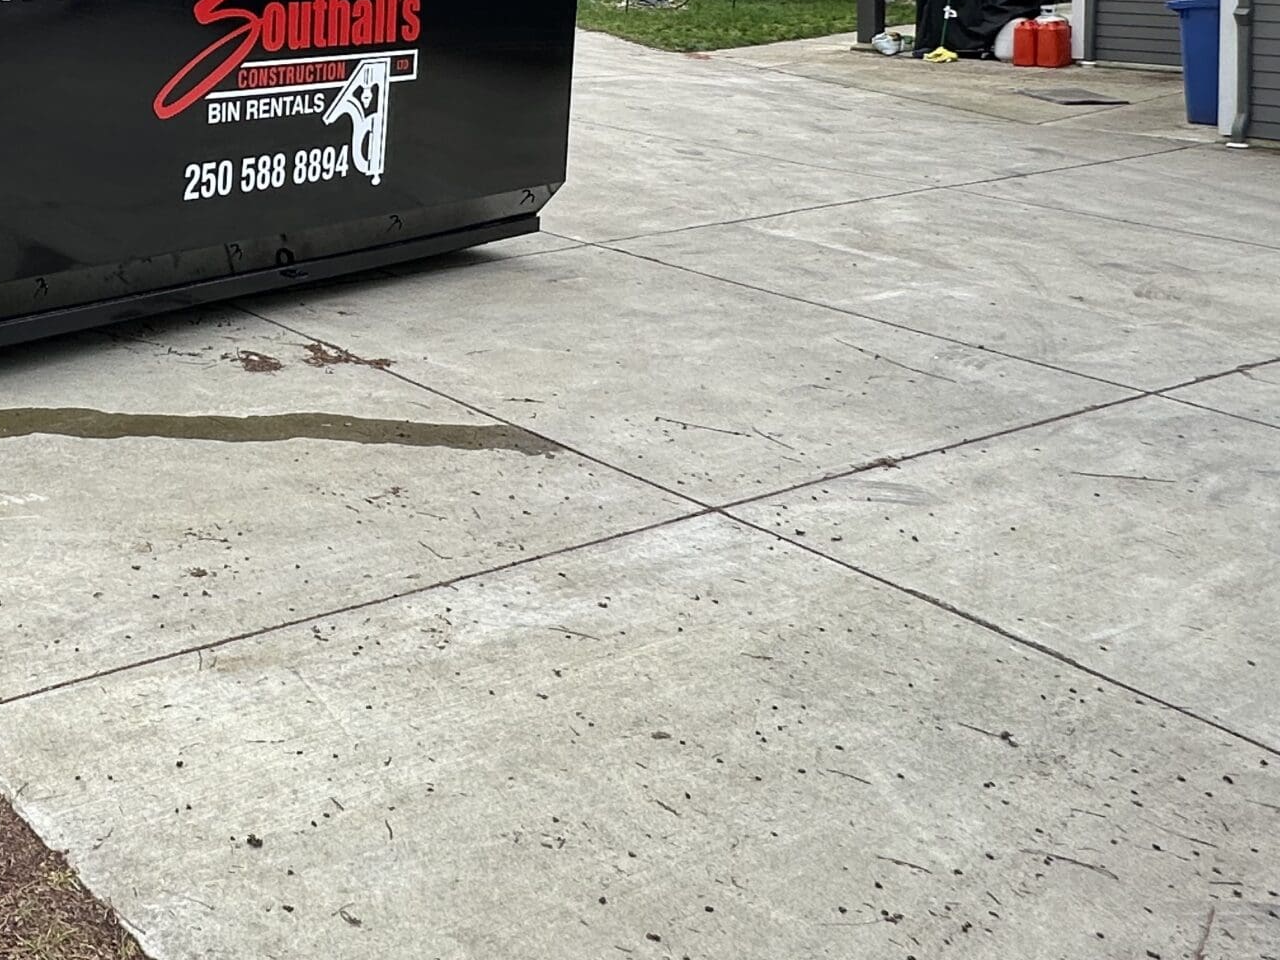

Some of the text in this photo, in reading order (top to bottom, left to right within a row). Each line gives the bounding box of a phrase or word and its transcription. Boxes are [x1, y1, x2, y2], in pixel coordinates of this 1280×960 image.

[237, 62, 346, 88] CONSTRUCTION
[207, 93, 325, 124] BIN RENTALS
[183, 144, 349, 201] 250 588 8894
